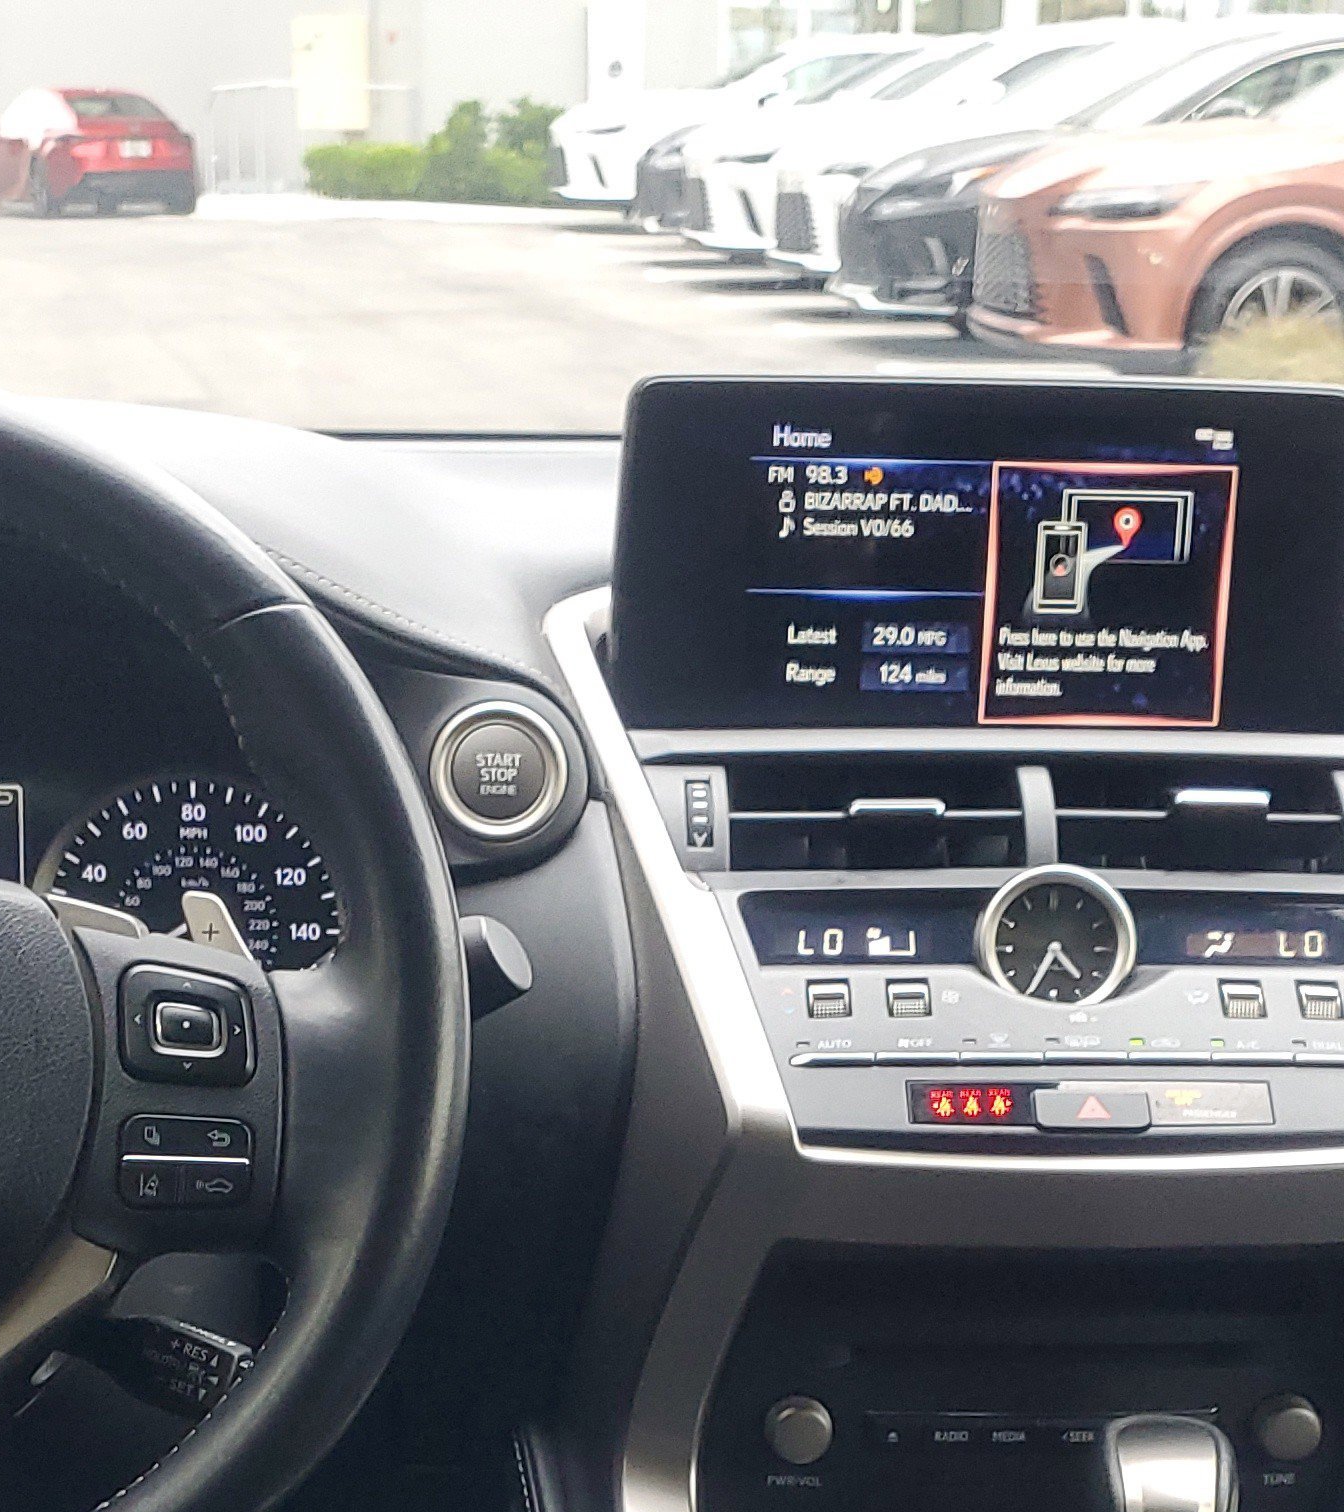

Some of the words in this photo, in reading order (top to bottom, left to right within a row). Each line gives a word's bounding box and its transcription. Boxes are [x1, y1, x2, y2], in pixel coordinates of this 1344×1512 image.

[772, 425, 833, 447] Home
[768, 465, 795, 483] FM
[806, 465, 848, 485] 98.3
[804, 492, 887, 511] BIZARRAP
[889, 493, 917, 512] FT.
[803, 517, 858, 537] Session
[787, 622, 838, 645] Latest
[872, 625, 916, 646] 29.0
[917, 631, 948, 646] MPG
[1032, 626, 1058, 647] here
[1059, 629, 1074, 647] to
[1074, 632, 1096, 648] use
[1097, 628, 1118, 648] the
[1119, 627, 1179, 652] Navigation
[998, 651, 1024, 671] Visit
[1026, 652, 1060, 672] Lexus
[1061, 654, 1105, 672] website
[1106, 653, 1125, 672] for
[1125, 658, 1156, 673] more
[785, 661, 837, 687] Range
[879, 662, 913, 684] 124
[995, 675, 1063, 697] information.
[476, 752, 522, 767] START
[480, 768, 518, 782] STOP
[180, 802, 207, 822] 80
[121, 822, 148, 841] 60
[178, 826, 208, 840] MPH
[234, 824, 268, 843] 100
[152, 864, 173, 877] 100
[174, 857, 194, 868] 120
[198, 857, 219, 869] 140
[81, 864, 107, 883] 40
[273, 867, 307, 887] 120
[136, 877, 153, 890] 80
[124, 895, 141, 908] 60
[248, 919, 271, 931] 220
[289, 922, 322, 942] 140
[817, 1039, 853, 1050] AUTO
[183, 1341, 209, 1362] RES
[934, 1430, 969, 1443] RADIO
[991, 1430, 1026, 1443] MEDIA
